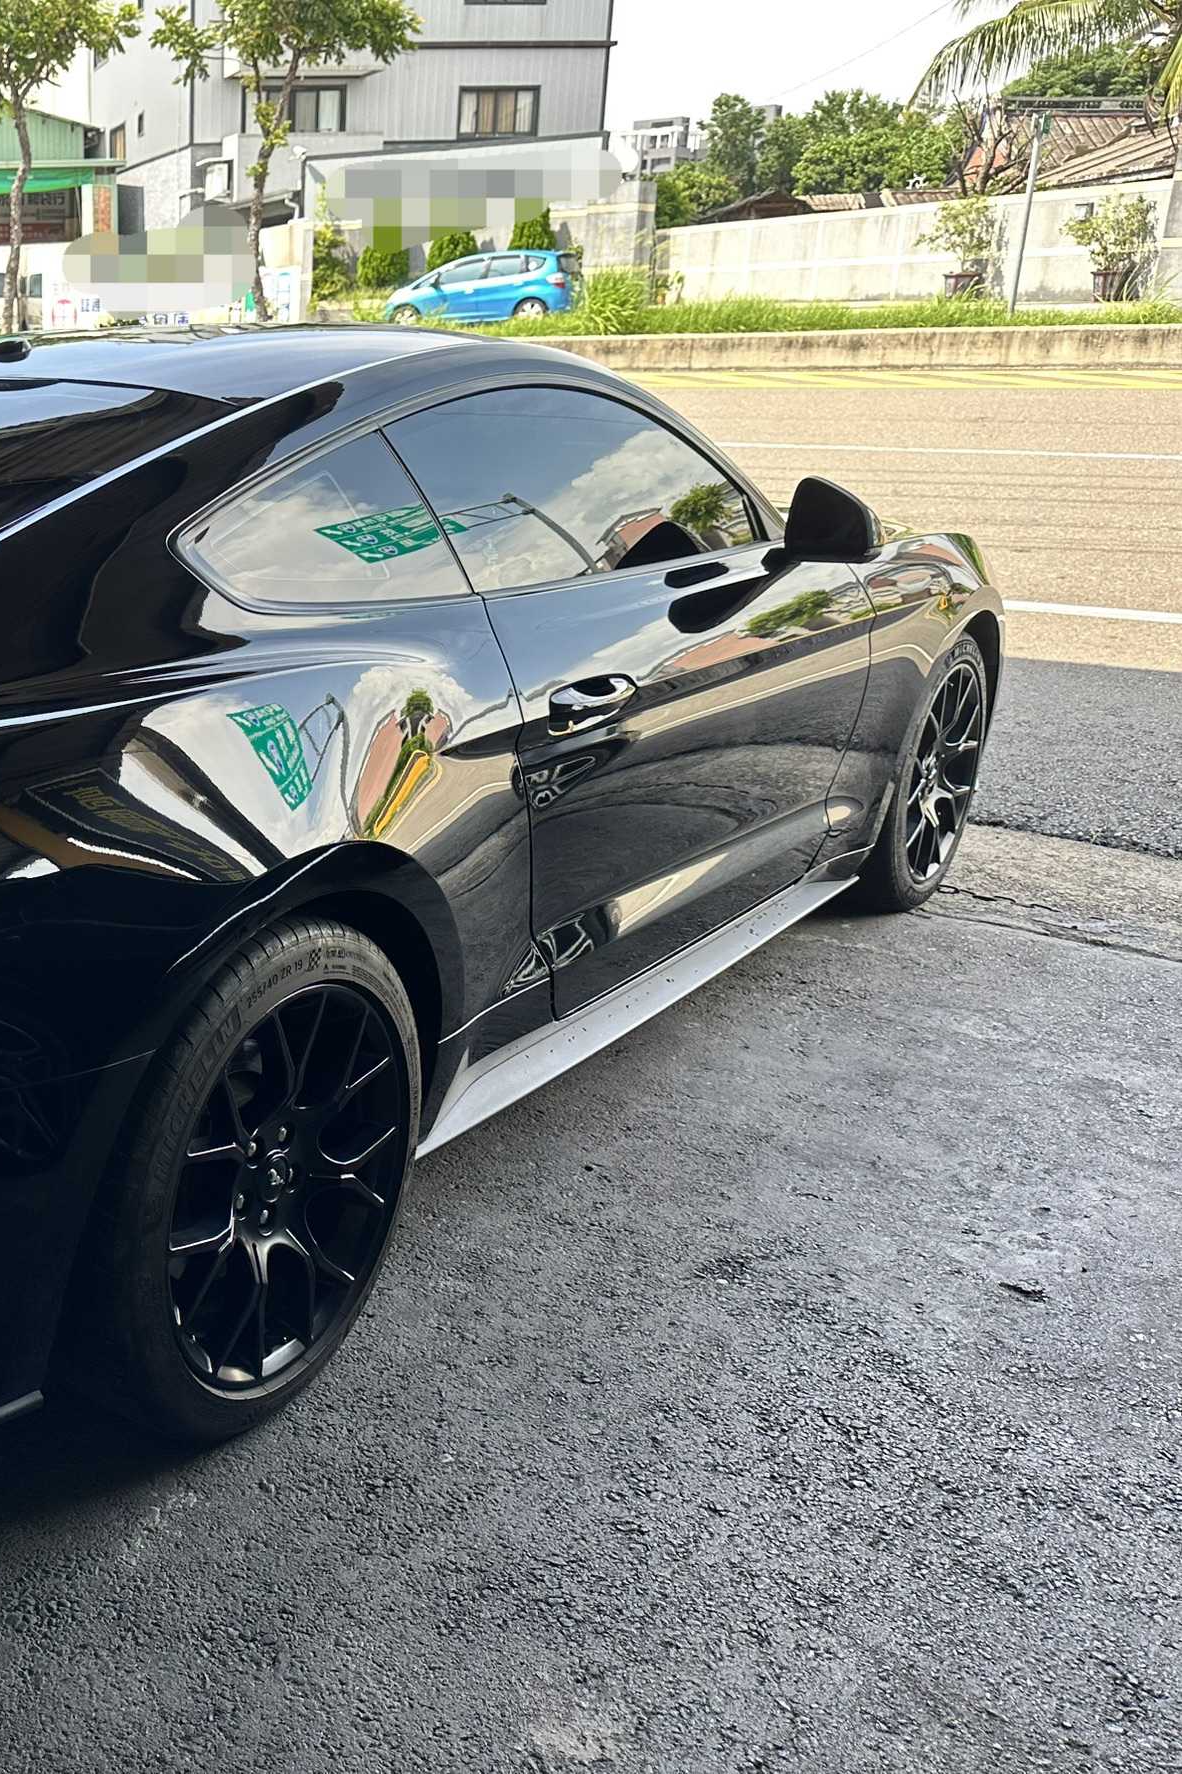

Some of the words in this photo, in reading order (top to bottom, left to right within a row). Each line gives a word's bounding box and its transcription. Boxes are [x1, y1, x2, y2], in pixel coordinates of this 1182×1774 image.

[246, 974, 278, 1008] 255/40
[281, 965, 292, 979] ZR
[294, 959, 303, 971] 19
[154, 1012, 239, 1184] MICHELIN
